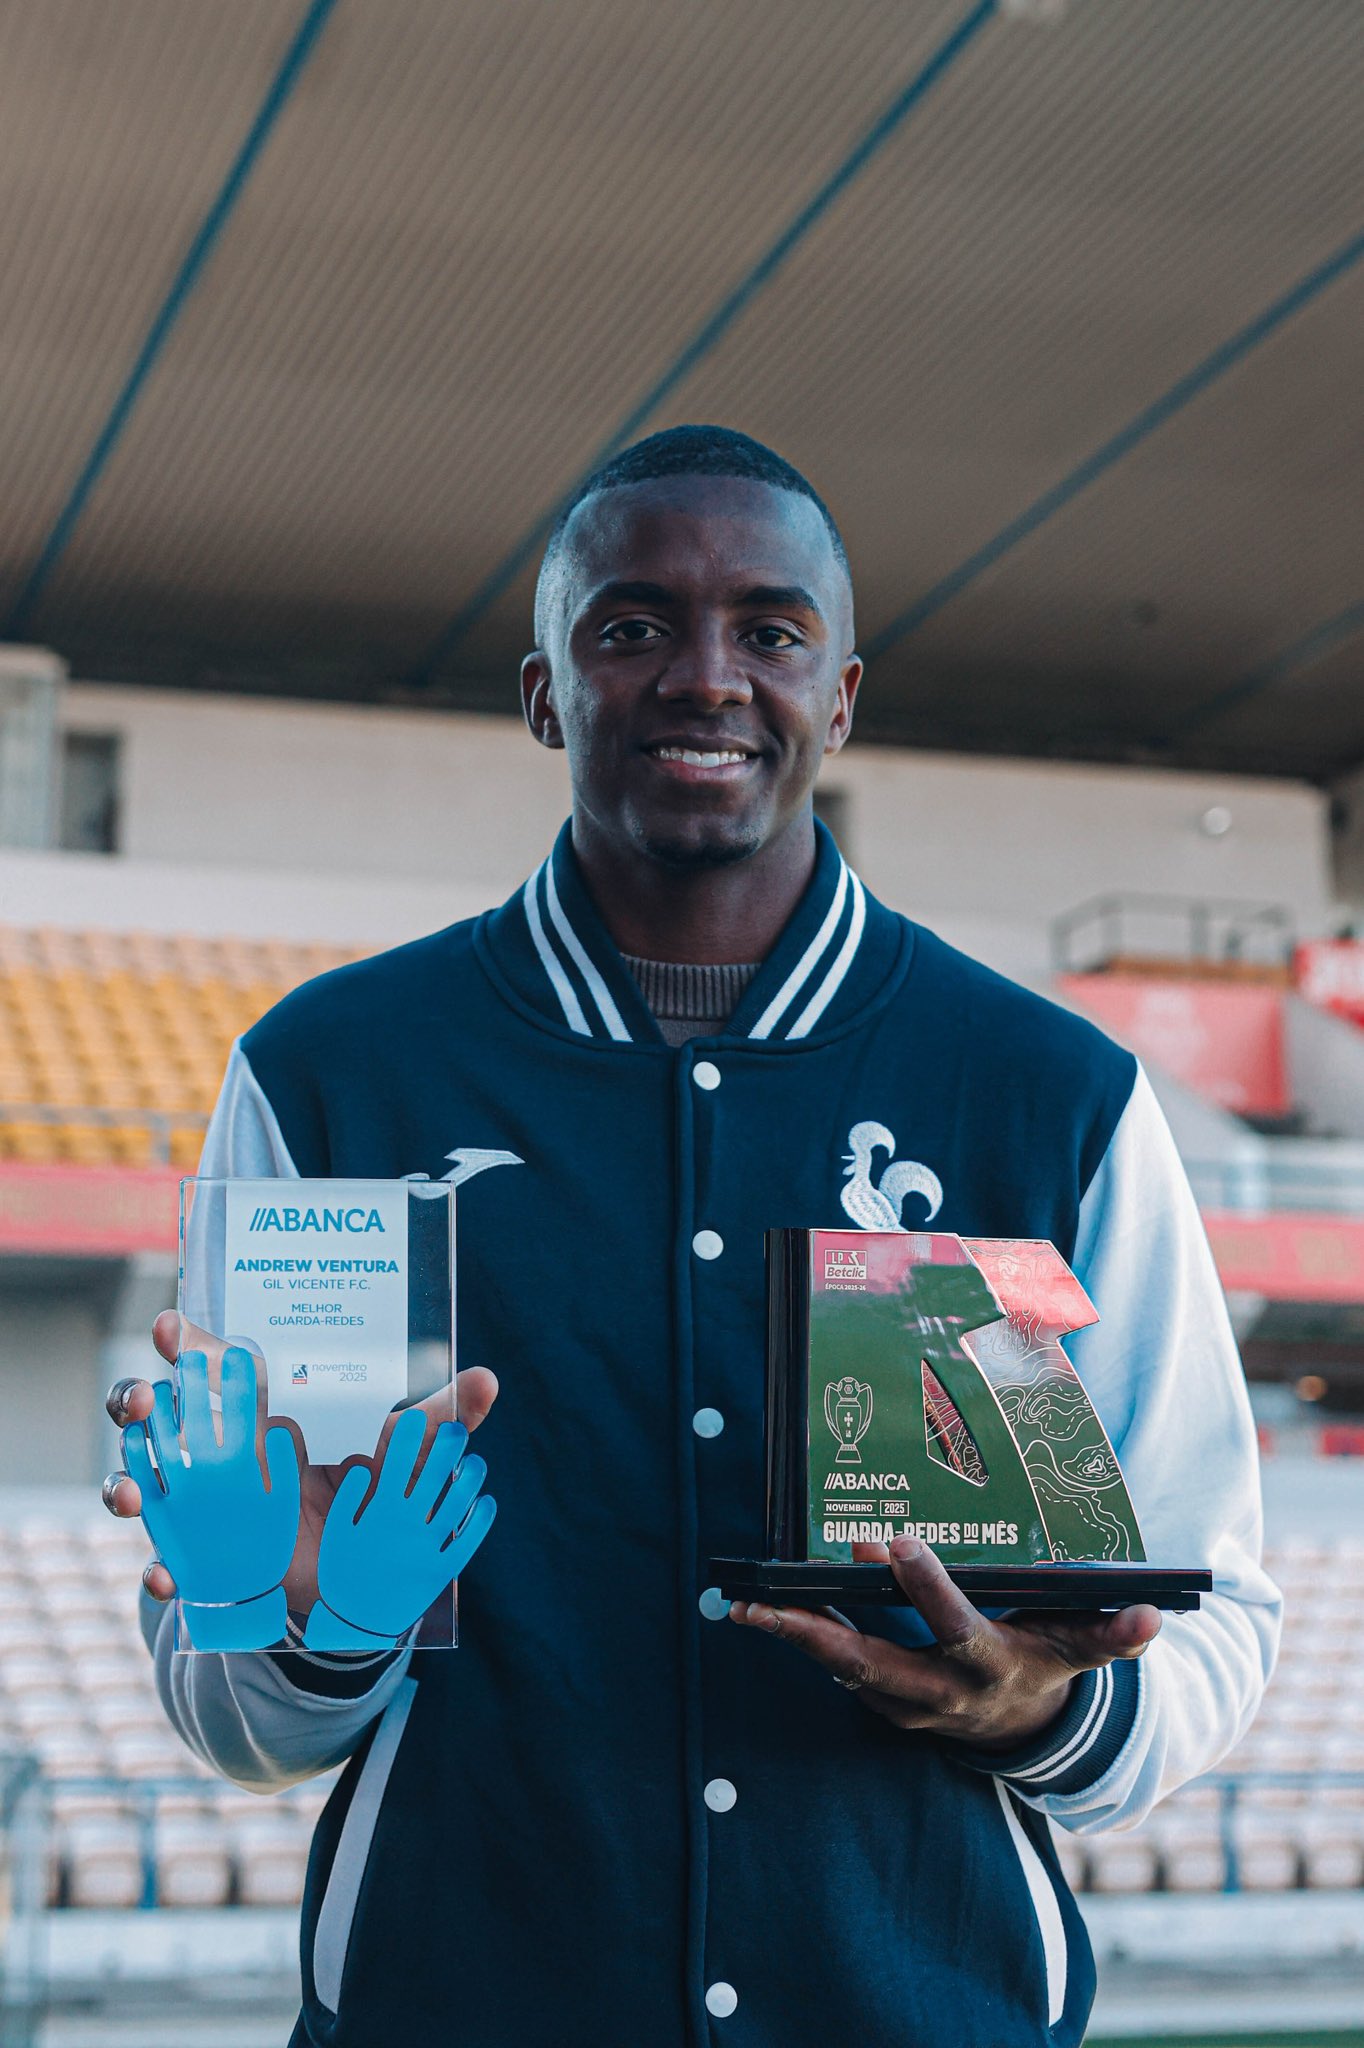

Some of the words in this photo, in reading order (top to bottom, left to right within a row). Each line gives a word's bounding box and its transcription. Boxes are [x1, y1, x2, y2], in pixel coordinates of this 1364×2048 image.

[234, 1259, 313, 1273] ANDREW
[317, 1259, 399, 1273] VENTURA
[826, 1266, 865, 1278] Betclic
[263, 1278, 284, 1290] GIL
[288, 1279, 345, 1290] VICENTE
[349, 1279, 371, 1290] F.C.
[825, 1282, 844, 1290] ÉPOCA
[291, 1303, 342, 1313] MELHOR
[269, 1315, 364, 1326] GUARDA-REDES
[312, 1362, 367, 1372] novembro
[339, 1372, 367, 1382] 2025
[825, 1503, 873, 1512] NOVEMBRO
[884, 1502, 905, 1514] 2025
[963, 1522, 979, 1539] DO
[982, 1520, 1018, 1545] MÊS
